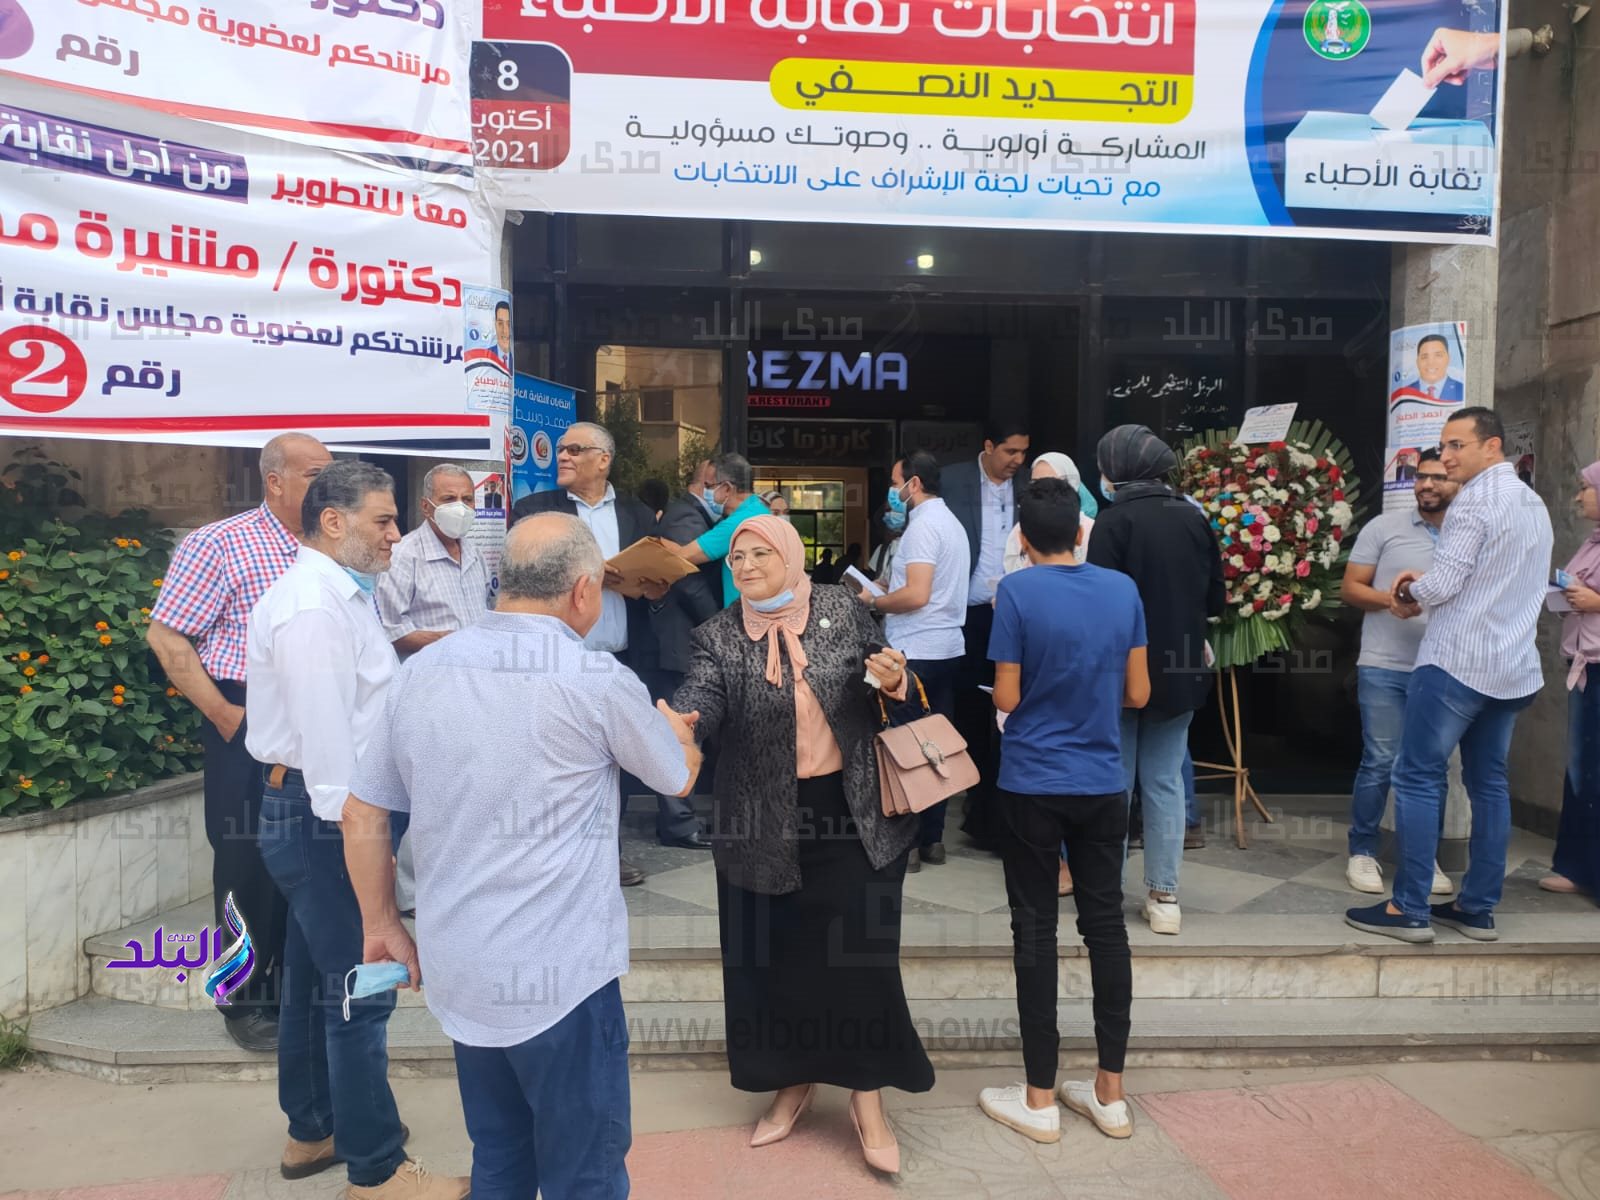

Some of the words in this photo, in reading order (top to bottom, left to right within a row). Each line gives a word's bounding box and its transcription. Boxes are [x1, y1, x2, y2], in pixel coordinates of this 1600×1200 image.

[77, 0, 190, 26] مج
[931, 0, 1176, 54] انتخابات
[198, 8, 320, 56] لعضوية
[56, 34, 140, 76] رقم
[328, 44, 451, 85] مرشحكم
[497, 60, 520, 92] 8
[796, 64, 990, 107] النصفي
[1001, 77, 1179, 113] التجديد
[0, 112, 93, 161] نقابة
[471, 106, 552, 134] أكتوب
[625, 115, 776, 148] مسؤولية
[474, 139, 539, 164] 2021
[786, 125, 909, 154] وصوتك
[943, 128, 1048, 159] أولوية
[1056, 132, 1206, 164] المشاركة
[105, 137, 171, 182] أجل
[182, 153, 232, 191] من
[674, 159, 798, 188] الانتخابات
[1304, 159, 1398, 191] الأطباء
[271, 173, 404, 217] للتطوير
[806, 166, 862, 192] على
[871, 165, 965, 197] الإشراف
[974, 170, 1029, 198] لجنة
[1037, 173, 1114, 201] تحيات
[1121, 178, 1161, 205] مع
[1408, 163, 1482, 195] نقابة
[412, 194, 468, 229] معا
[75, 210, 260, 279] مشيرة
[272, 241, 299, 292] /
[308, 246, 464, 307] دكتورة
[14, 286, 109, 322] نقابة
[117, 305, 223, 337] مجلس
[230, 313, 343, 346] لعضوية
[7, 339, 69, 398] 2
[101, 360, 181, 397] رقم
[514, 387, 529, 399] العام
[748, 425, 787, 449] كاف
